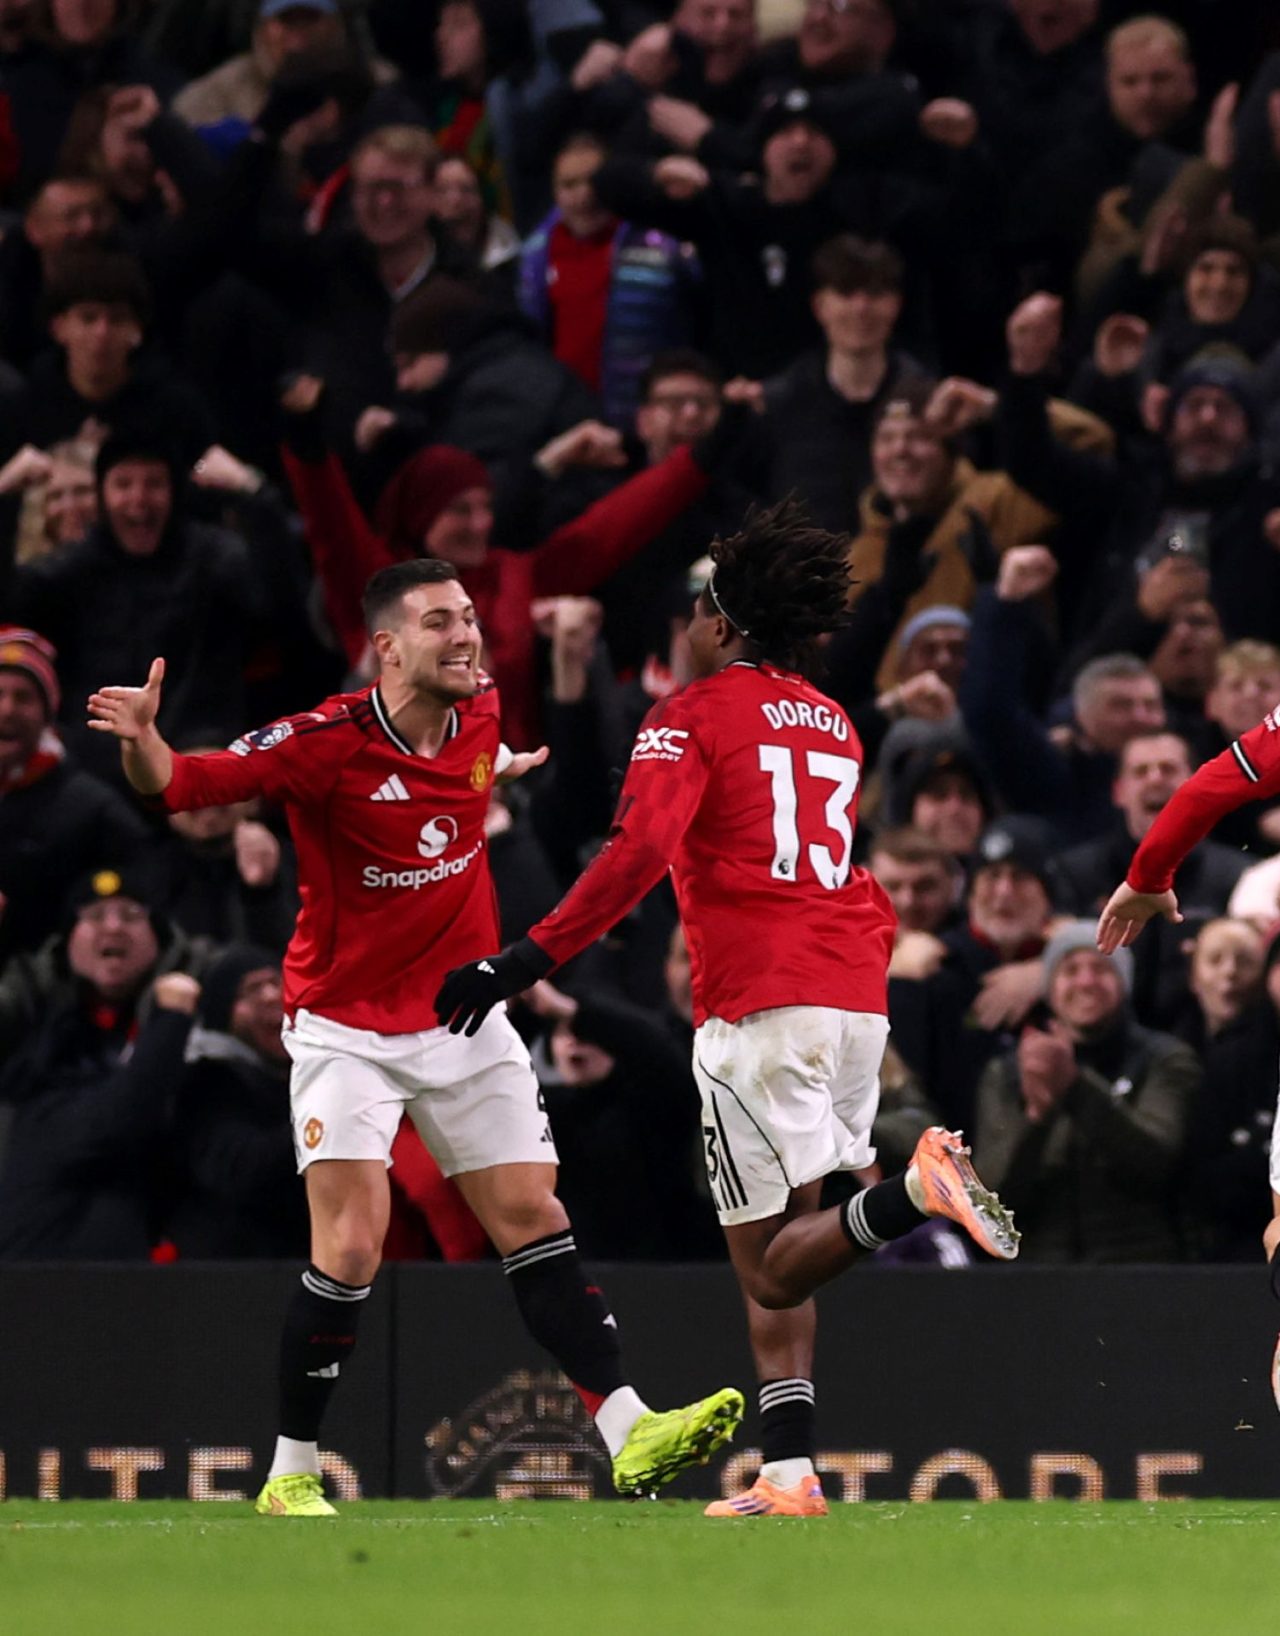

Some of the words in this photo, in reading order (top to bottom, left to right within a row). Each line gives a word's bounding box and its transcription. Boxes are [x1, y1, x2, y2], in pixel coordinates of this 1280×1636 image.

[760, 699, 848, 742] DORGU
[758, 744, 860, 890] 13
[362, 840, 483, 890] Snapdra
